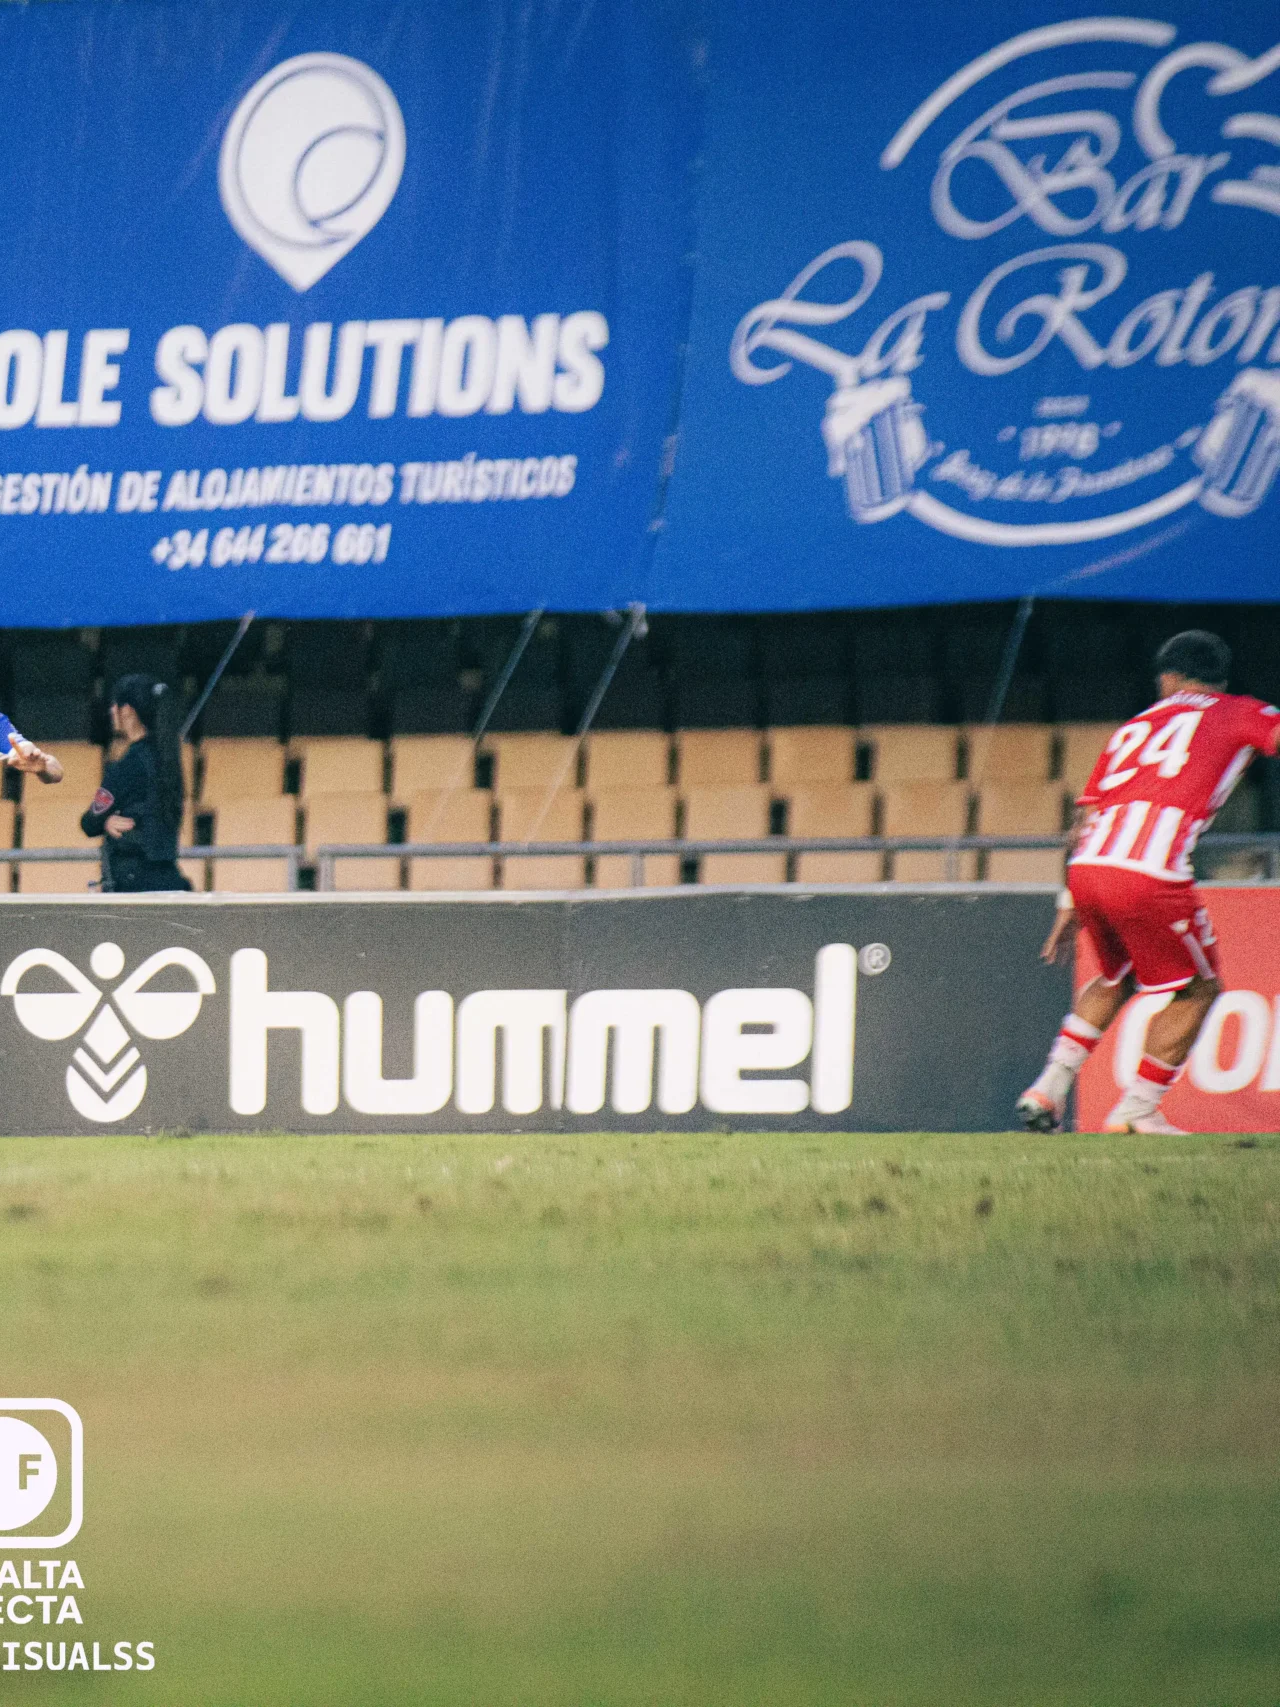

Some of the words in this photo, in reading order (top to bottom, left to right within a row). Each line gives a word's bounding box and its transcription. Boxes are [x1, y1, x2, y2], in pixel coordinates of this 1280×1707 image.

[931, 72, 1230, 240] Bar
[150, 310, 610, 427] SOLUTIONS
[730, 240, 951, 385] La
[115, 470, 162, 513] DE
[161, 462, 396, 512] ALOJAMIENTOS
[399, 451, 578, 505] TURÍSTICOS
[1098, 710, 1205, 792] 24
[228, 942, 858, 1116] hummel
